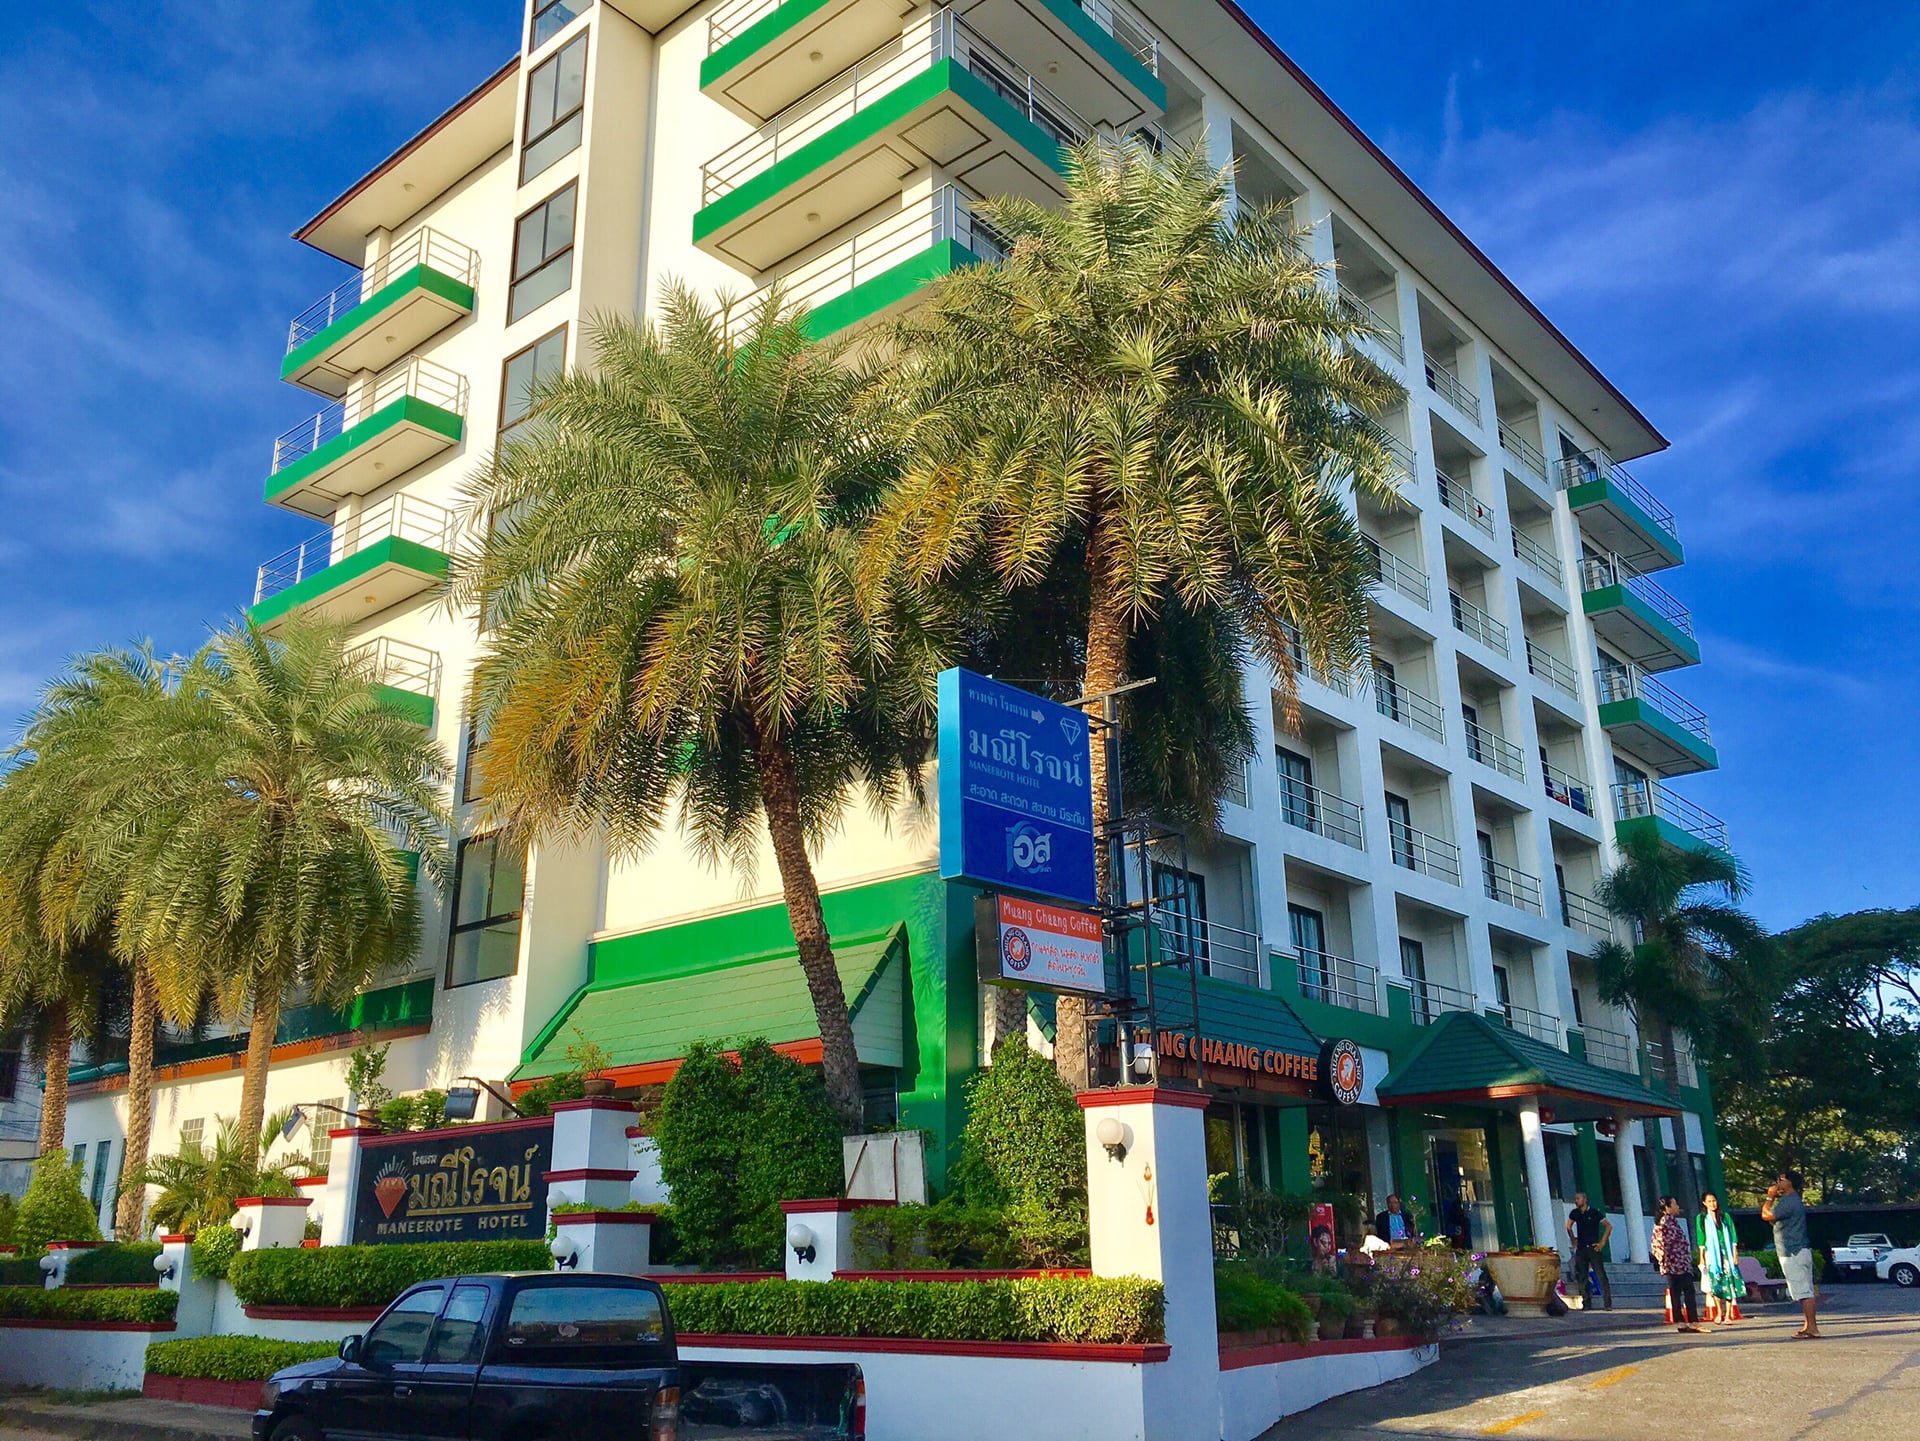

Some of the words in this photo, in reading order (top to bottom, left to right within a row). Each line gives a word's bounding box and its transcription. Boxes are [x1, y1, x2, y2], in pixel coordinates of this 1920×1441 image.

[968, 728, 1083, 787] มณีโรจน์
[968, 760, 1015, 781] MANEEROTE
[1016, 775, 1041, 789] HOTEL
[1003, 901, 1033, 926] Muang
[1070, 916, 1097, 934] Coffee
[1189, 1036, 1259, 1071] CHAANG
[1263, 1049, 1318, 1081] COFFEE
[1334, 1083, 1359, 1102] COFFEE
[412, 1151, 438, 1166] โรงแรม
[408, 1144, 539, 1209] มณีโรจน์
[377, 1217, 463, 1235] MANEEROTE
[478, 1214, 529, 1230] HOTEL
